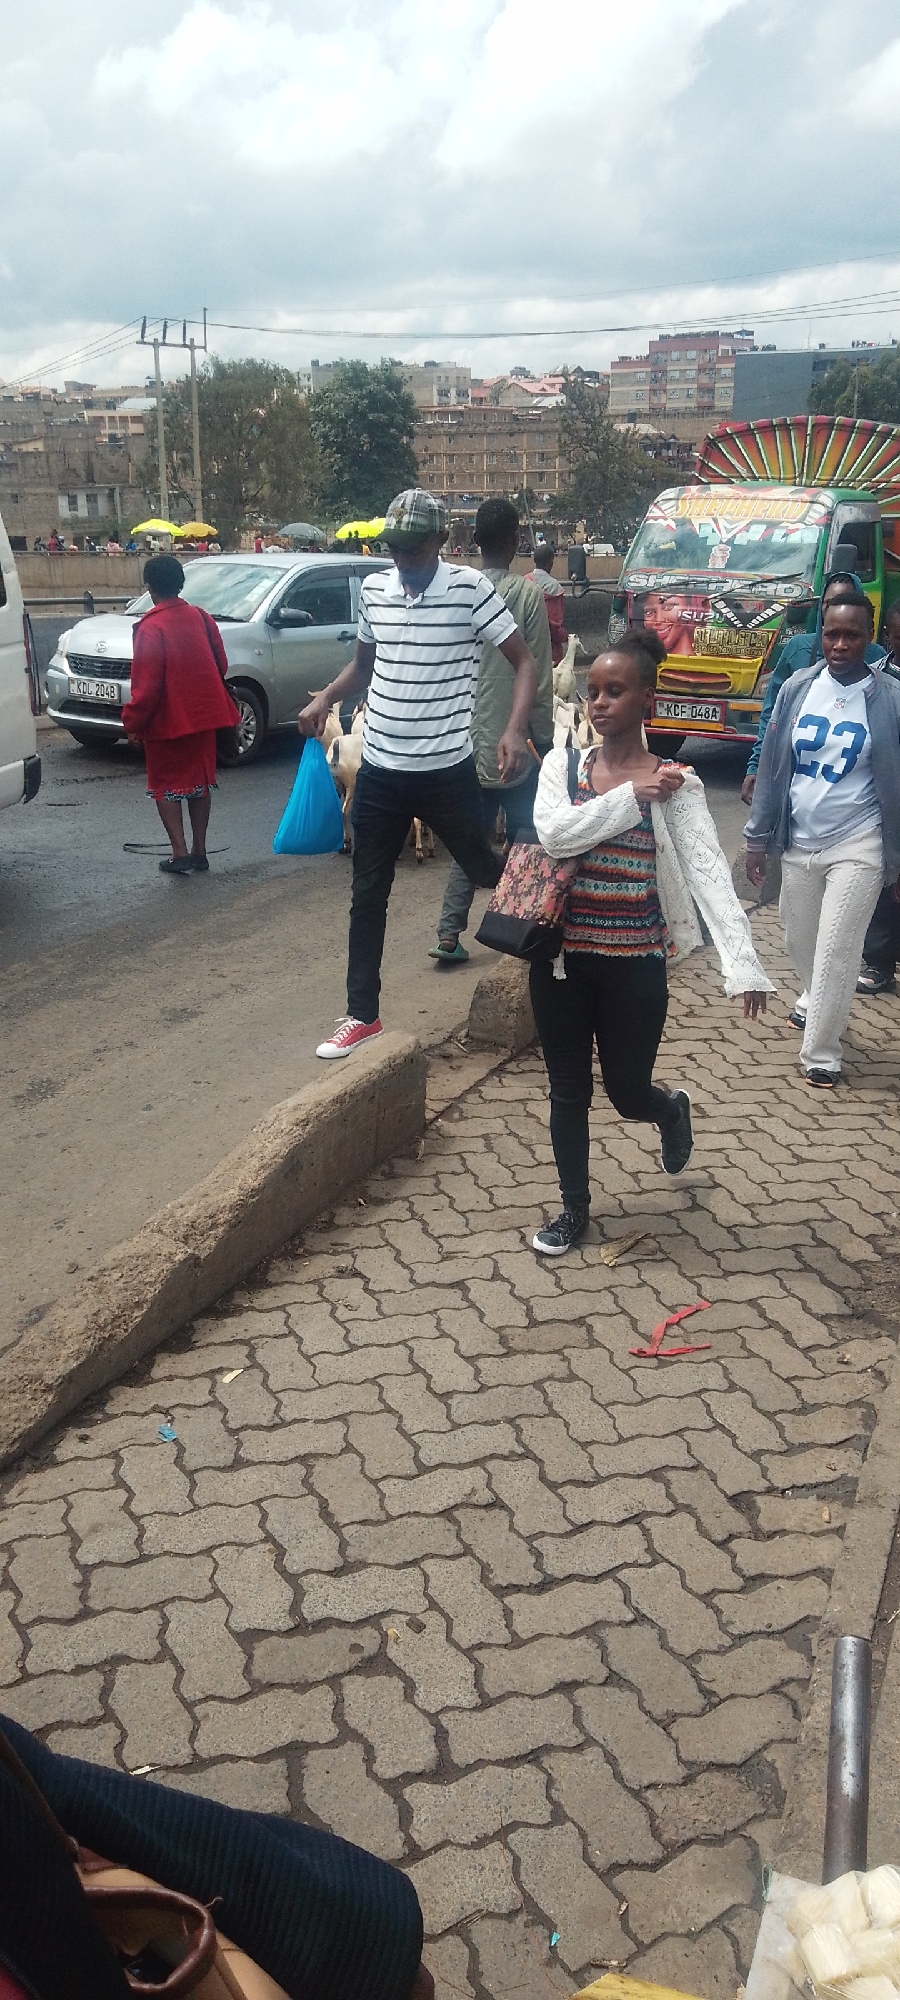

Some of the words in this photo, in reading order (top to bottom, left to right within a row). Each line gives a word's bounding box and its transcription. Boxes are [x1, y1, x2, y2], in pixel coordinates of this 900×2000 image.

[676, 493, 809, 520] SHEPHERD
[627, 573, 804, 598] SHEPHERD
[677, 610, 725, 623] ISUZU
[77, 680, 92, 695] KDL
[95, 684, 115, 698] 204B
[666, 704, 687, 717] KCF
[690, 706, 718, 720] 048A
[795, 714, 867, 784] 23
